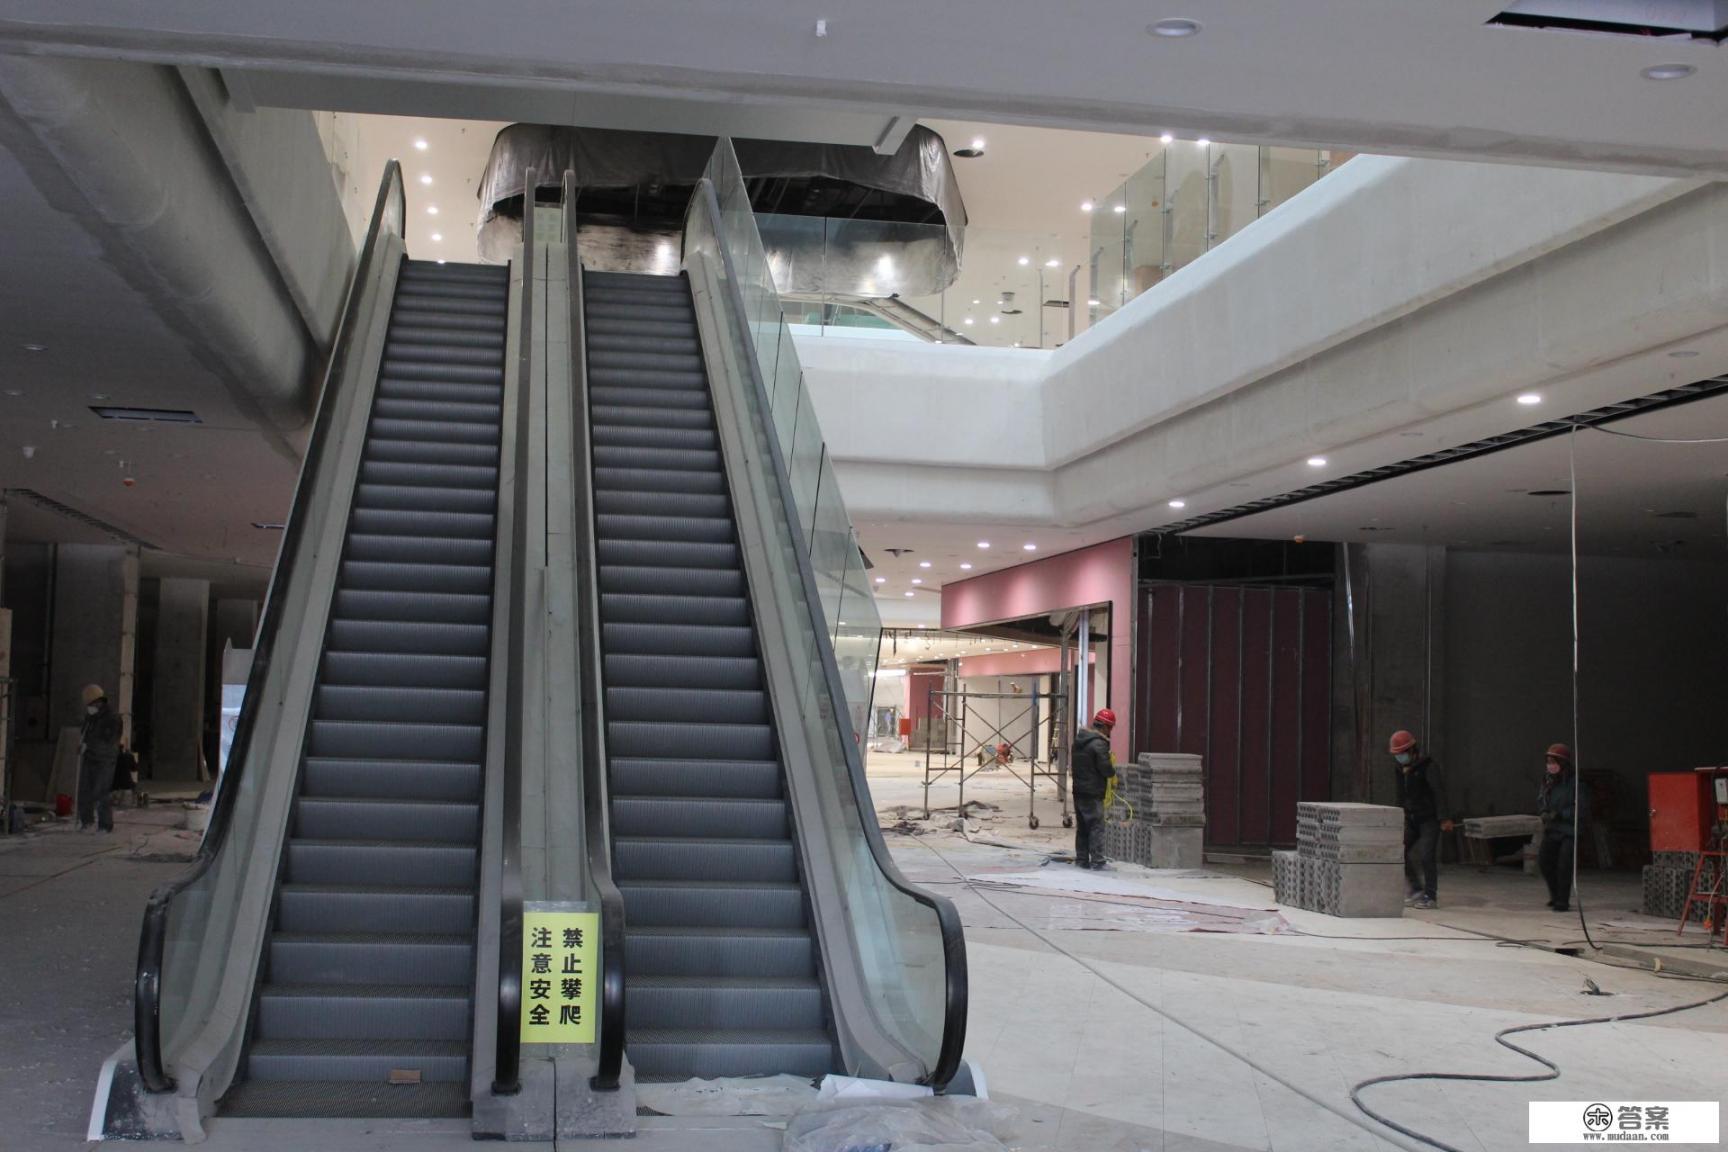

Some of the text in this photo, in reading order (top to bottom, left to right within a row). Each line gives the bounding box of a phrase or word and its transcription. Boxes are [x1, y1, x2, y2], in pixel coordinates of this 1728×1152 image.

[529, 926, 553, 1026] 注意安全
[559, 926, 584, 1026] 禁止攀爬
